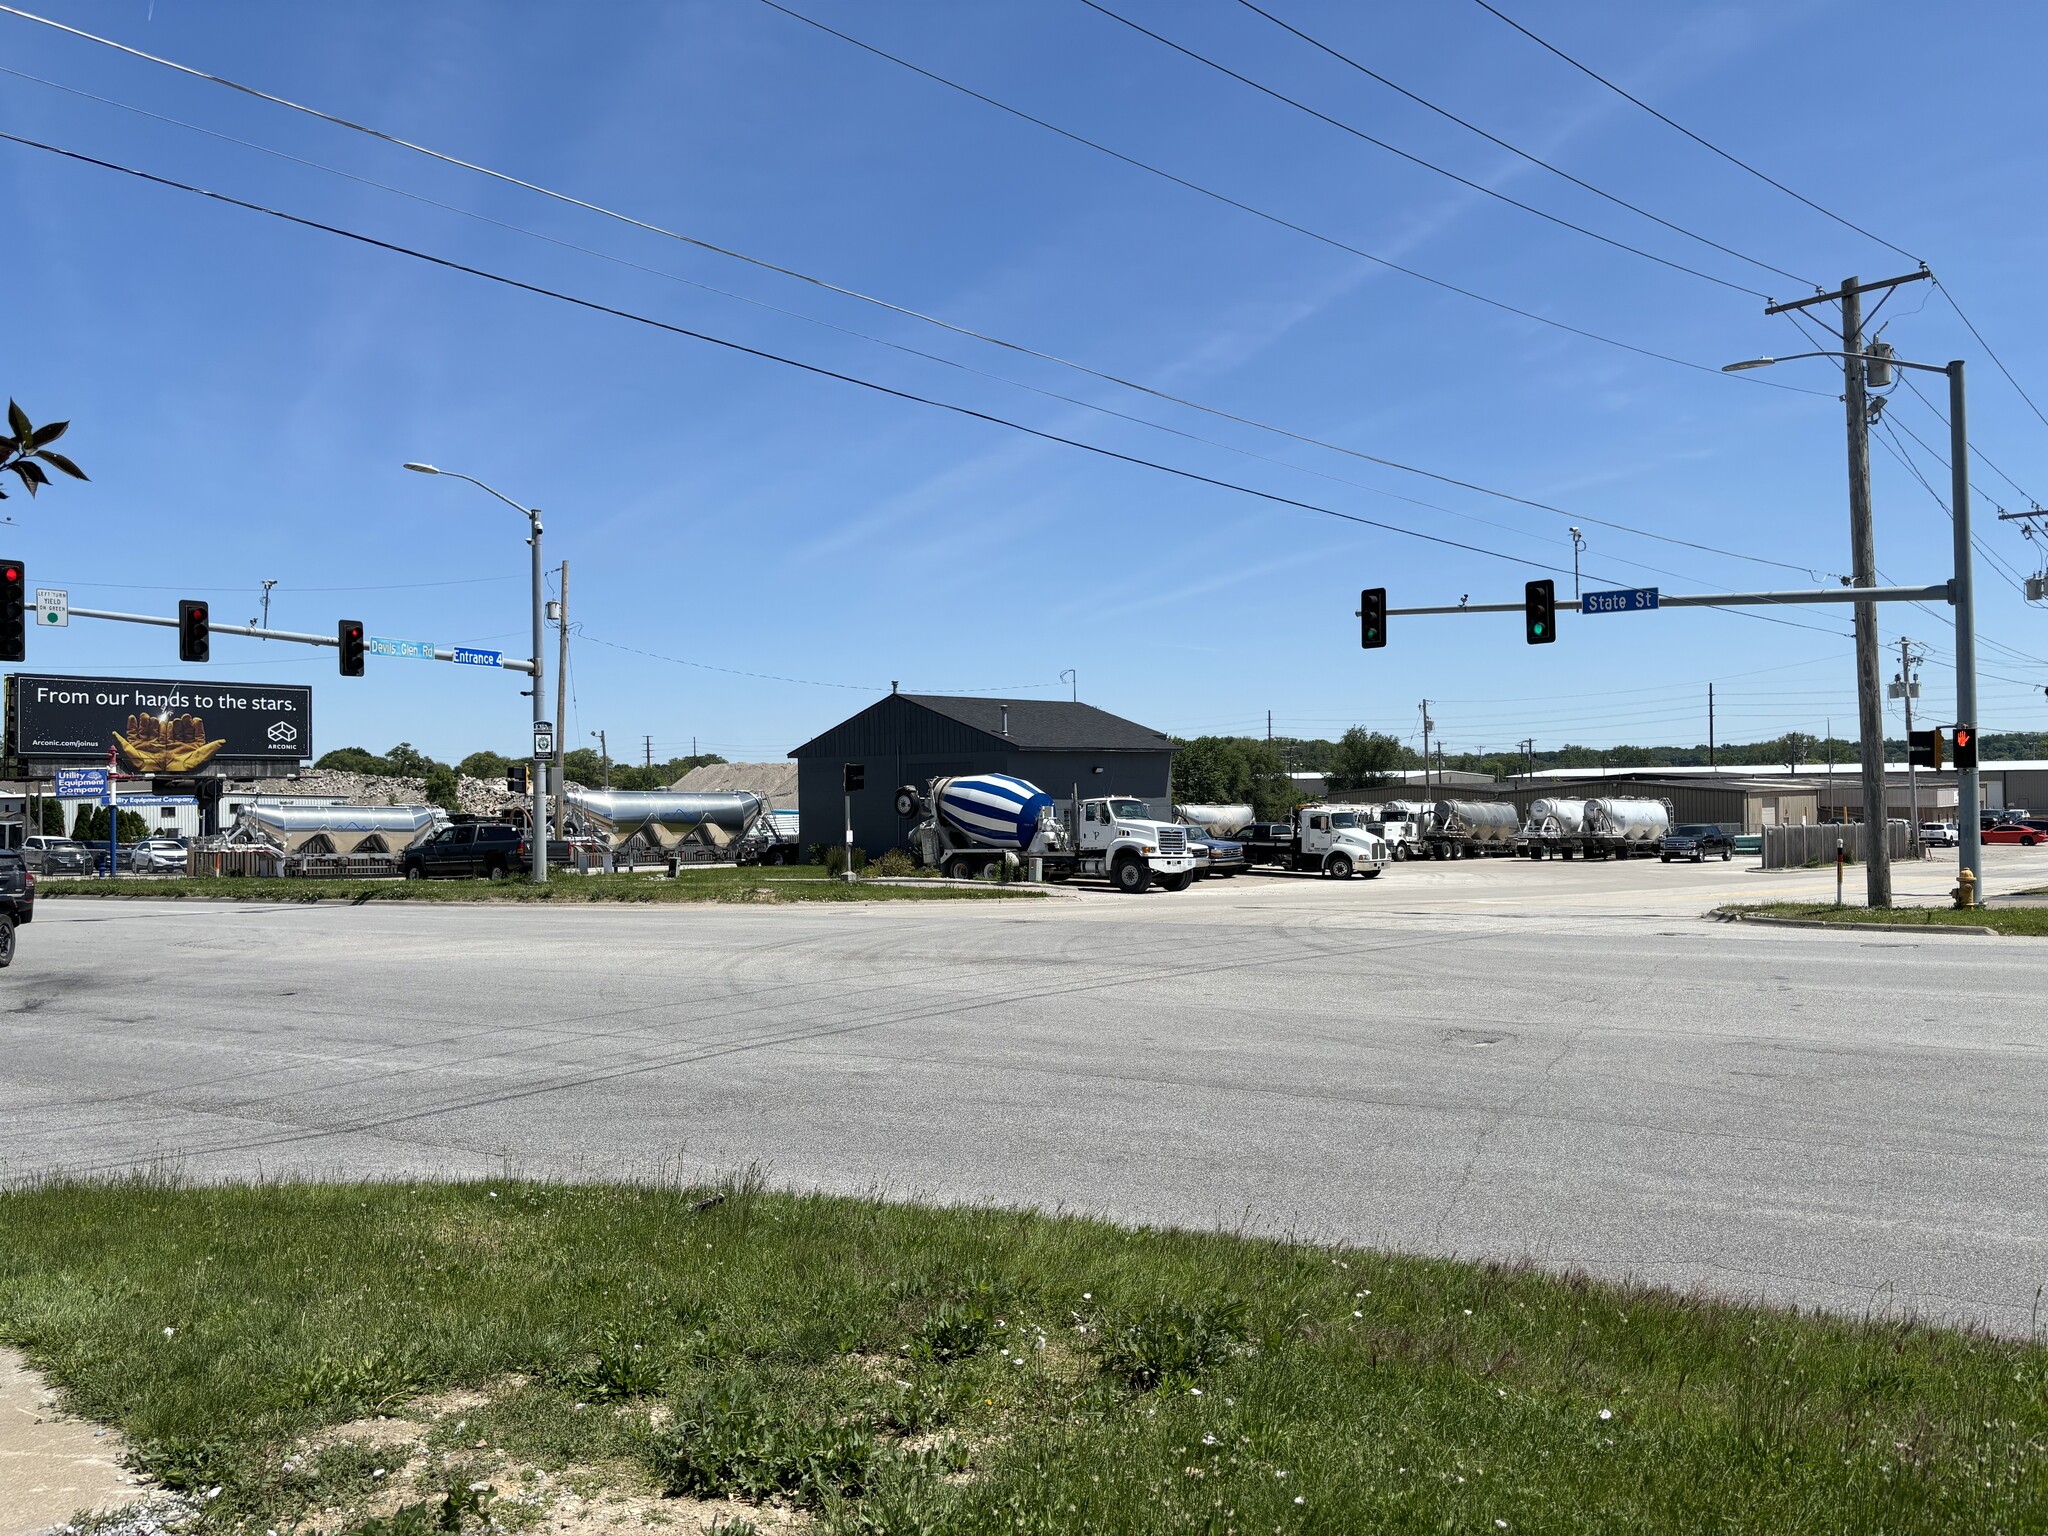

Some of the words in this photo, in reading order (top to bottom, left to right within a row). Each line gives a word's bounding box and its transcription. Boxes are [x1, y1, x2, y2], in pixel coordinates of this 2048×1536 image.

[1589, 594, 1626, 611] State
[1635, 592, 1652, 608] St
[371, 640, 396, 654] Devils
[401, 643, 419, 656] Glen
[422, 646, 433, 657] Rd
[453, 650, 493, 665] Entrance
[495, 653, 503, 665] 4
[37, 687, 89, 704] From
[95, 693, 129, 706] our
[135, 690, 189, 708] hands
[194, 694, 213, 708] to
[218, 693, 247, 709] the
[252, 697, 297, 711] stars.
[32, 739, 99, 748] Arconic.com/joinus
[58, 772, 86, 780] Utility
[58, 779, 104, 787] Equipment
[59, 786, 104, 794] Company
[162, 796, 194, 804] Company
